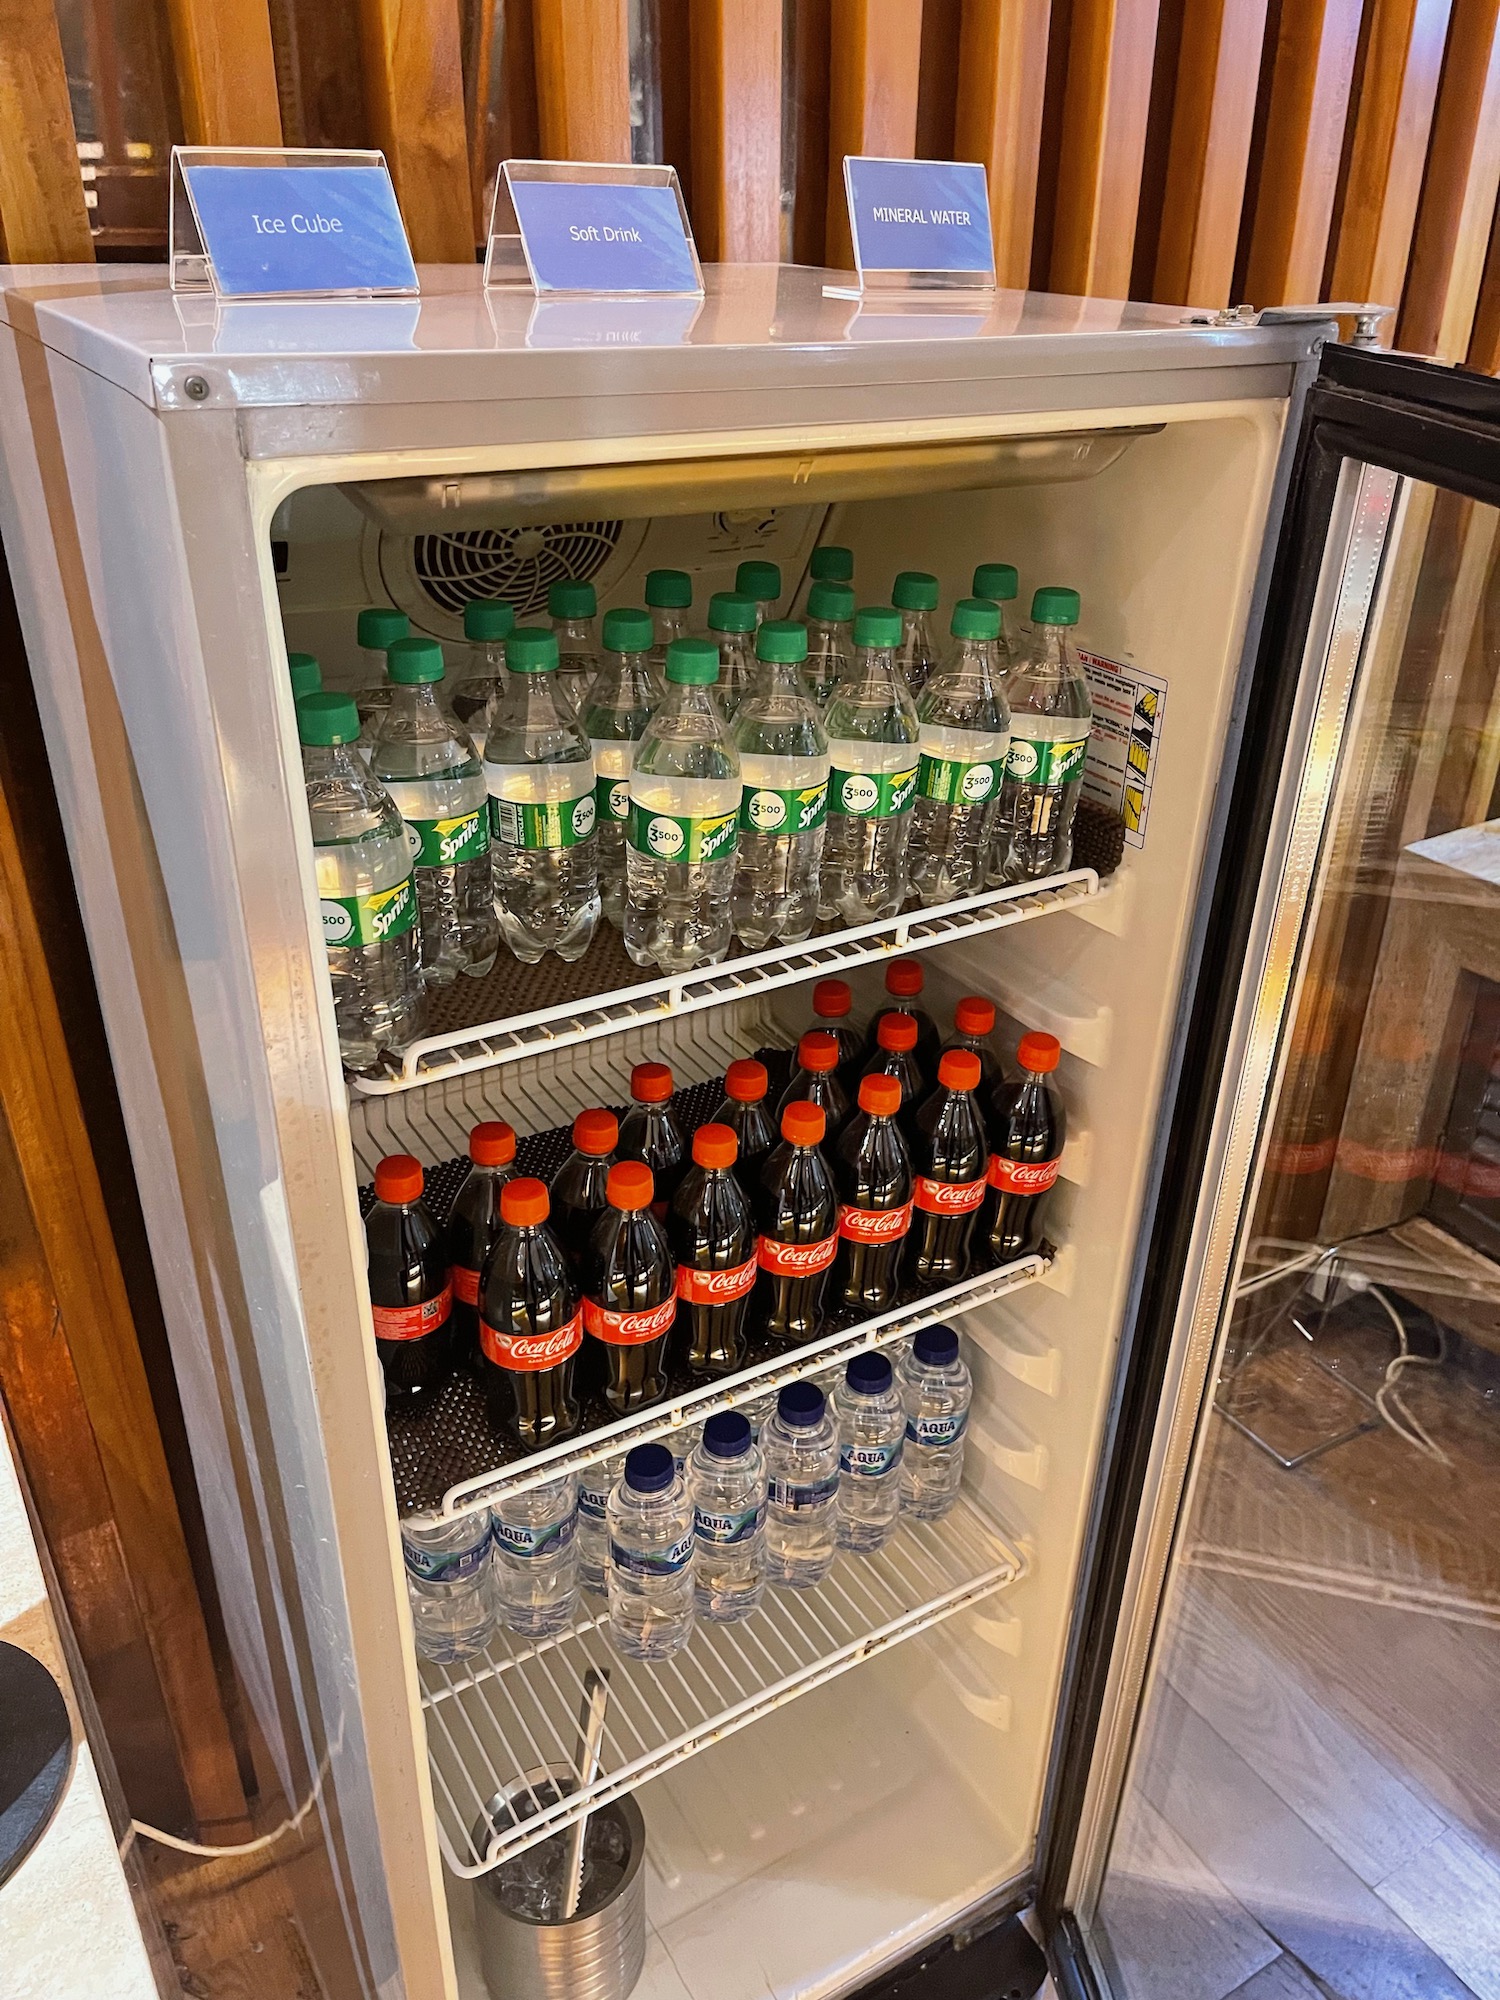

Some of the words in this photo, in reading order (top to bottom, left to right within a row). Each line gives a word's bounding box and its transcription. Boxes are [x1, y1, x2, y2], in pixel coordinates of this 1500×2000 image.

[251, 214, 287, 234] Ice
[291, 213, 344, 234] Cube
[873, 206, 928, 224] MINERAL
[930, 209, 972, 226] WATER
[569, 225, 601, 242] Soft
[603, 226, 643, 242] Drink
[1092, 656, 1119, 674] WARNING
[1006, 750, 1033, 764] 3500
[1048, 745, 1085, 781] Sprite
[844, 786, 873, 800] 3500
[889, 774, 918, 812] Sprit
[964, 775, 991, 790] 3500
[611, 794, 627, 807] 35
[750, 803, 781, 817] 3500
[574, 807, 594, 828] 3500
[439, 817, 479, 861] Sprite
[649, 827, 679, 843] 3500
[698, 818, 735, 859] Sprite
[322, 915, 346, 925] 500
[371, 887, 410, 939] Sprite
[1009, 1160, 1060, 1183] Coca-Col
[844, 1208, 906, 1232] Coca-Cola
[777, 1236, 836, 1265] Coca-Cola
[707, 1256, 758, 1293] Coca-Col
[510, 1322, 576, 1359] Coca-Cola
[918, 1420, 956, 1435] AQUA
[847, 1449, 886, 1465] AQUA
[581, 1490, 608, 1506] AQU
[694, 1511, 734, 1531] AQUA
[496, 1523, 534, 1544] AQUA
[404, 1543, 432, 1568] QUA
[671, 1536, 692, 1560] AQ
